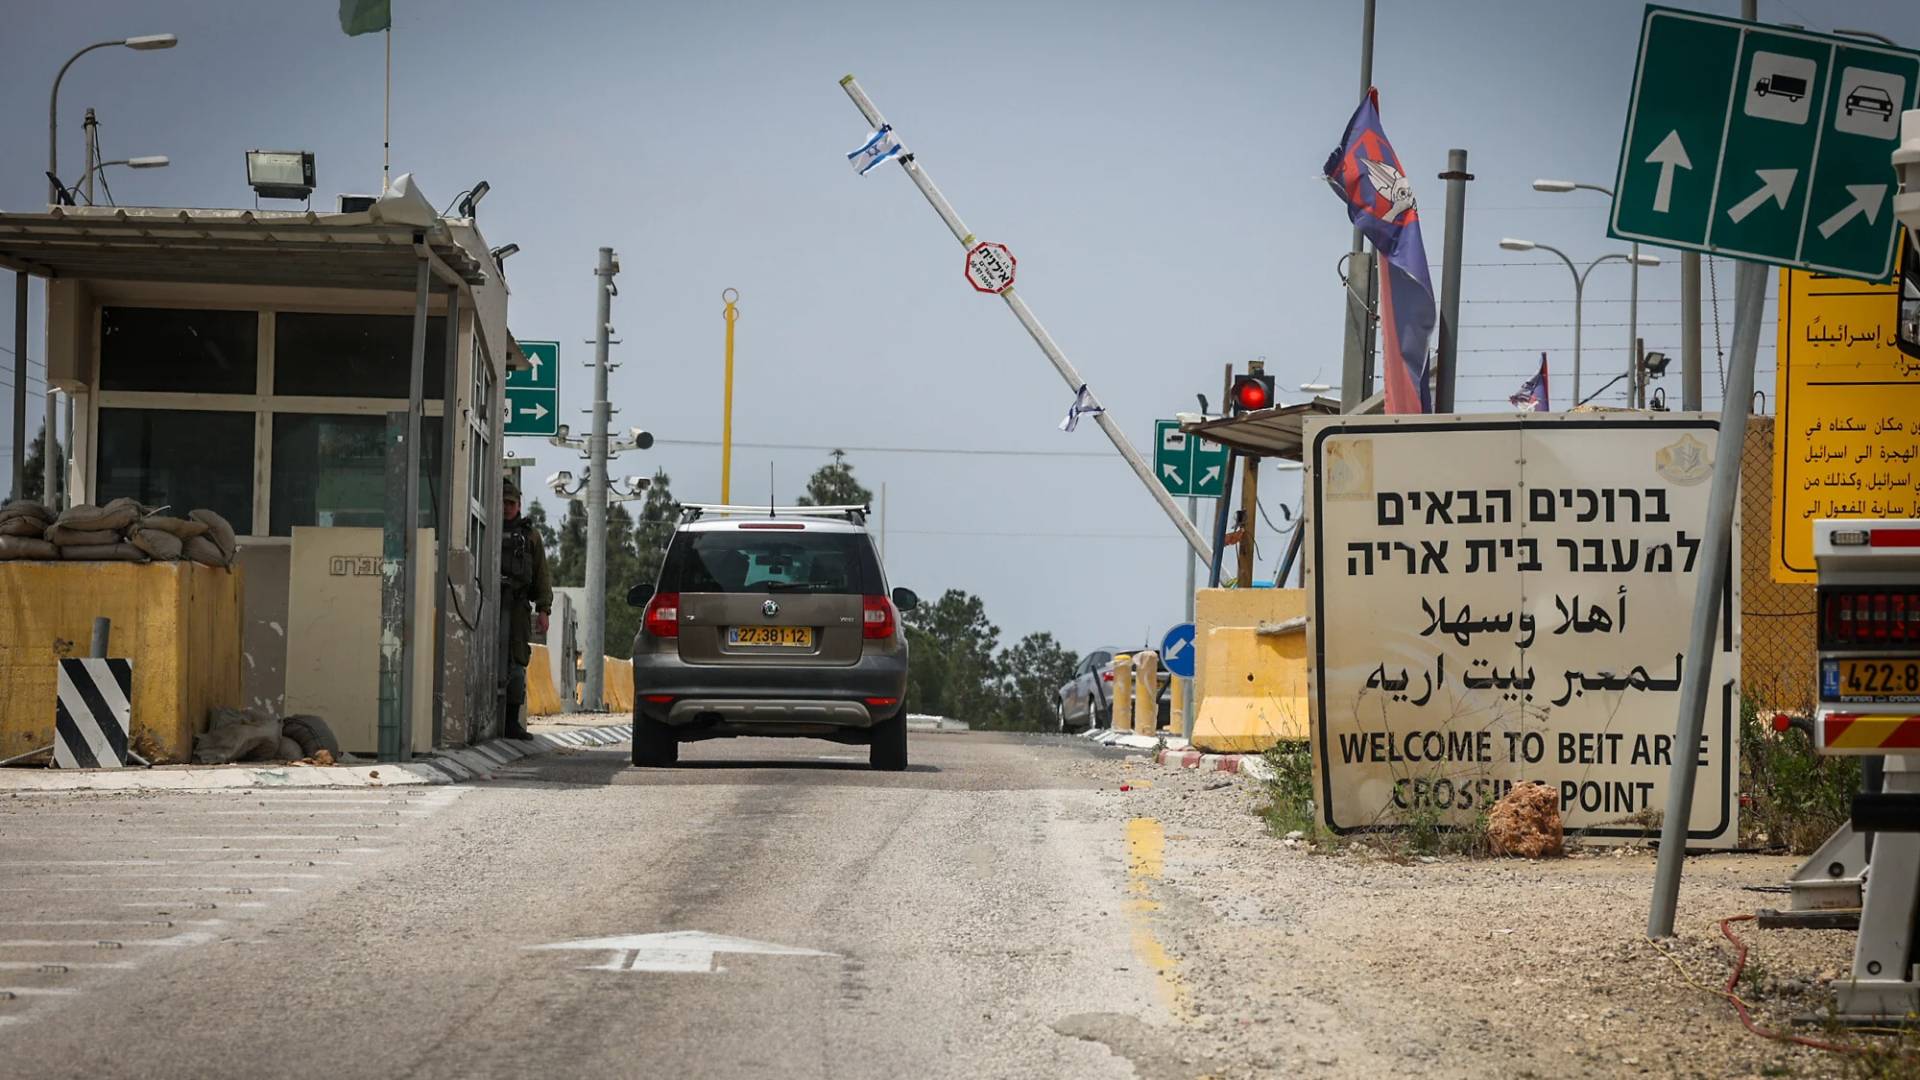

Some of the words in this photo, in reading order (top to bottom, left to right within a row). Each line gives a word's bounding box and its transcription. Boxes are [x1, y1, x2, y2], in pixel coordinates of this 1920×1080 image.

[979, 247, 1010, 283] אילנית
[1805, 417, 1822, 441] في
[1829, 417, 1867, 432] سكناه
[1874, 417, 1904, 435] مكان
[1880, 444, 1918, 463] الهجرة
[1803, 476, 1820, 490] من
[1824, 472, 1862, 490] وكذلك
[1376, 488, 1512, 526] הבאים
[1529, 488, 1671, 523] ברוכים
[1826, 499, 1866, 518] المفعول
[1871, 500, 1904, 518] سارية
[1347, 540, 1449, 576] אריה
[1466, 538, 1542, 574] בית
[1556, 530, 1701, 573] למעבר
[1419, 595, 1536, 648] وسهلا
[1553, 585, 1627, 634] أهلا
[1366, 653, 1444, 706] اريه
[1463, 658, 1536, 701] بيت
[1340, 732, 1491, 764] WELCOME
[1504, 732, 1544, 763] TO
[1557, 733, 1623, 765] BEIT
[1631, 733, 1709, 766] ARE
[1393, 778, 1546, 811] CROSSI
[1561, 781, 1654, 812] POINT
